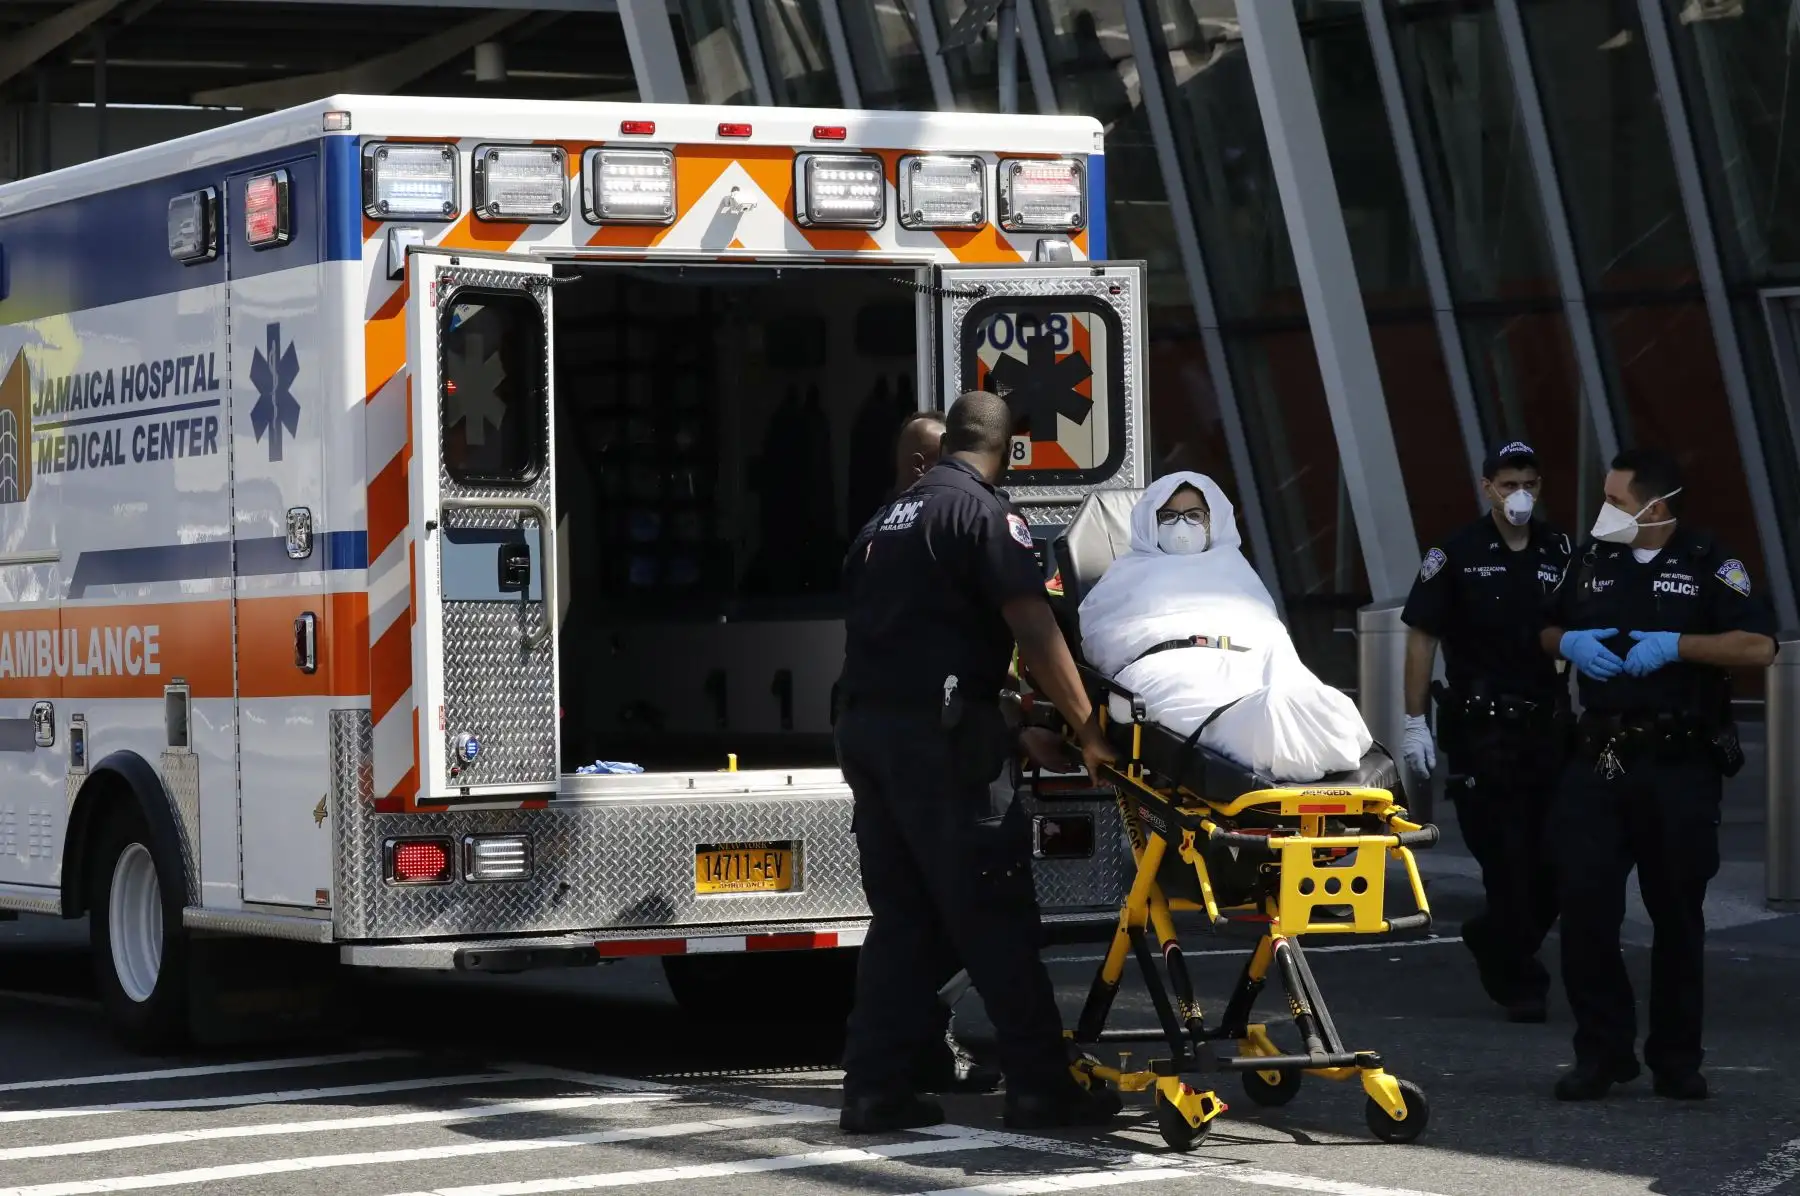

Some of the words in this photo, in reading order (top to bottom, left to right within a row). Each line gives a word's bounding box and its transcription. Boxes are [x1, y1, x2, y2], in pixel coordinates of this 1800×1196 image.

[977, 313, 1069, 351] 008
[33, 368, 115, 417] JAMAICA
[120, 351, 220, 404] HOSPITAL
[37, 428, 126, 475] MEDICAL
[132, 415, 219, 463] CENTER
[1012, 441, 1026, 460] 8
[883, 500, 924, 524] JHMC
[1653, 580, 1699, 596] POLICE
[0, 625, 161, 678] AMBULANCE
